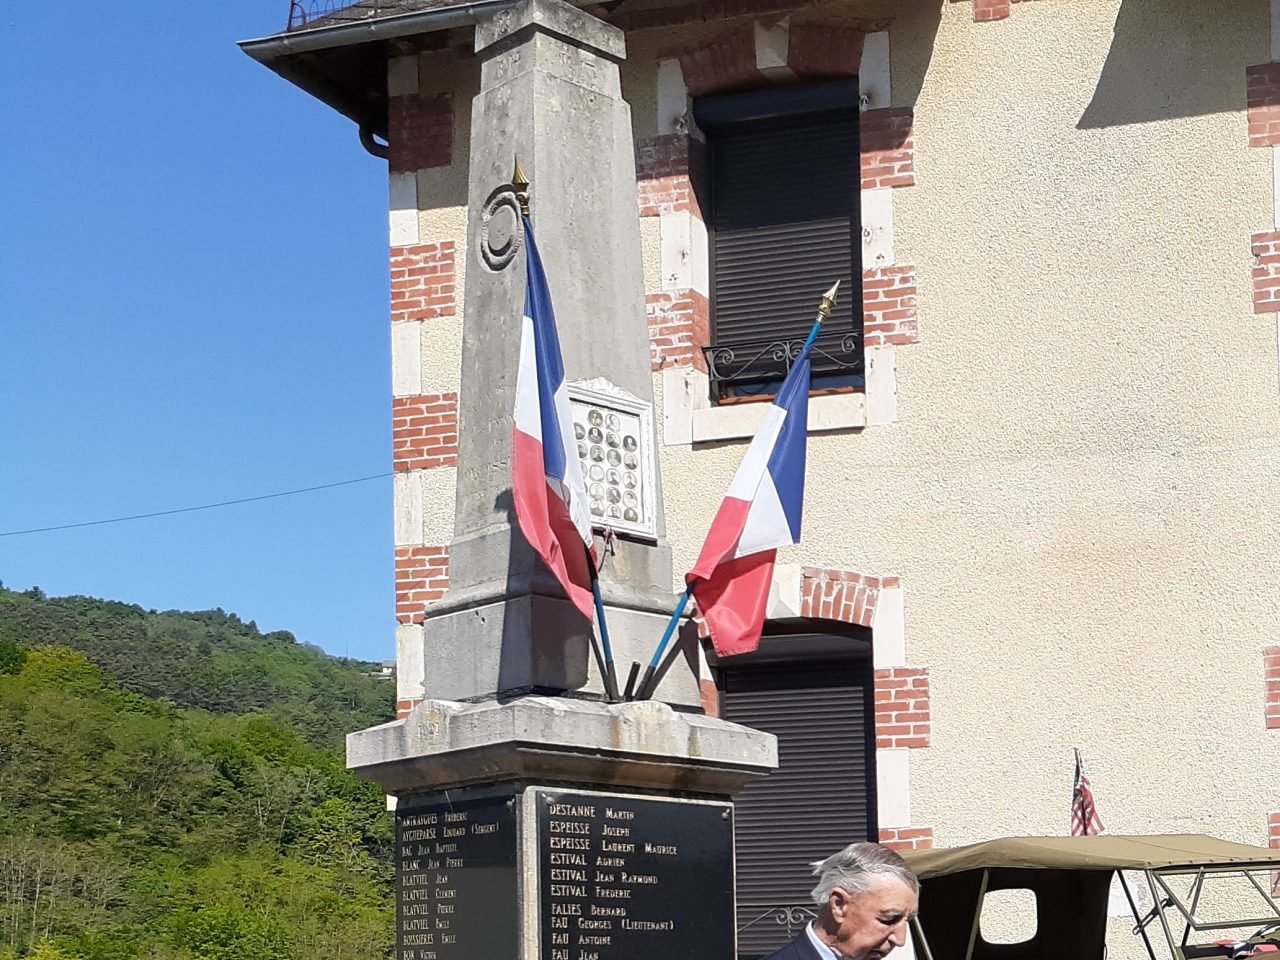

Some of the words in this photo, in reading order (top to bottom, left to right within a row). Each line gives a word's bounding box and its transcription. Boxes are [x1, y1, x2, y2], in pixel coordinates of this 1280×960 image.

[550, 804, 595, 817] DESTANNE
[550, 821, 590, 834] ESPEISSE
[550, 837, 590, 850] ESPEISSE
[551, 853, 587, 865] ESTIVAL
[551, 869, 587, 881] ESTIVAL
[551, 885, 587, 896] ESTIVAL
[551, 917, 568, 928] FAU
[552, 933, 569, 944] FAU
[552, 949, 568, 960] FAU
